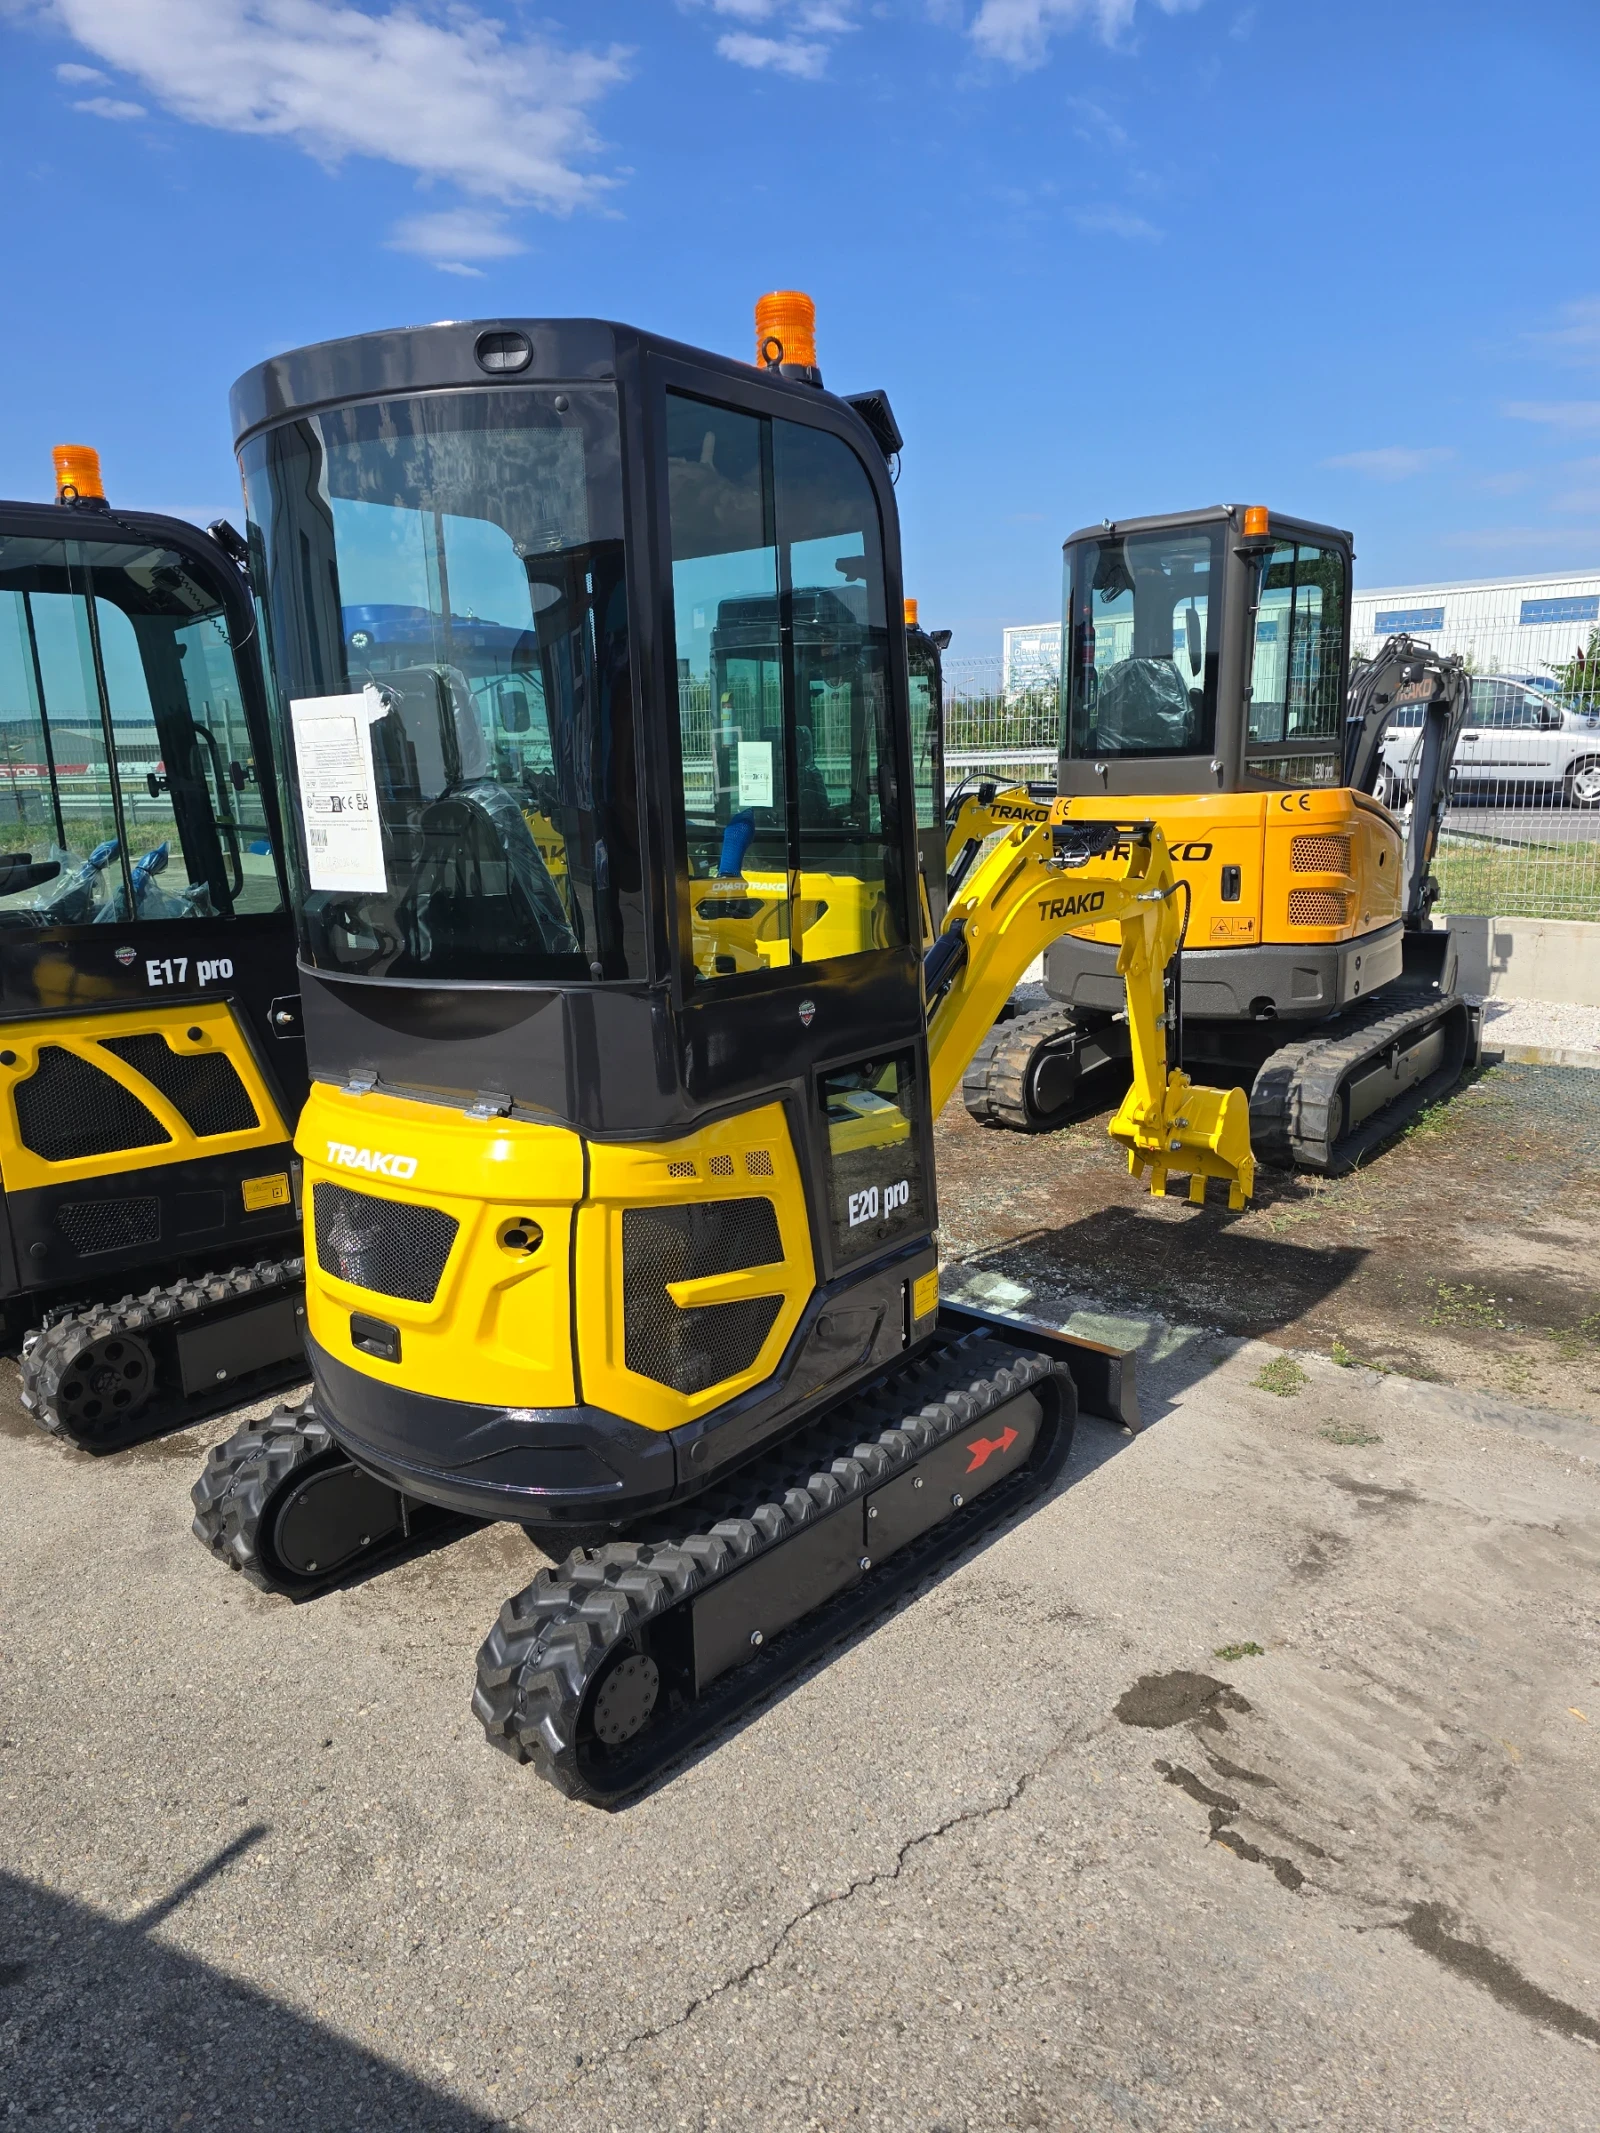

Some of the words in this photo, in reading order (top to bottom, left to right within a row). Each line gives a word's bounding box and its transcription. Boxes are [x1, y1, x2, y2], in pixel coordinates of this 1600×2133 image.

[989, 804, 1049, 822] TRAKO
[1037, 890, 1105, 922] TRAKO
[145, 957, 189, 986] E17
[196, 958, 234, 987] pro
[326, 1141, 418, 1180] TRAKO
[848, 1185, 879, 1228] E20
[883, 1179, 910, 1220] pro
